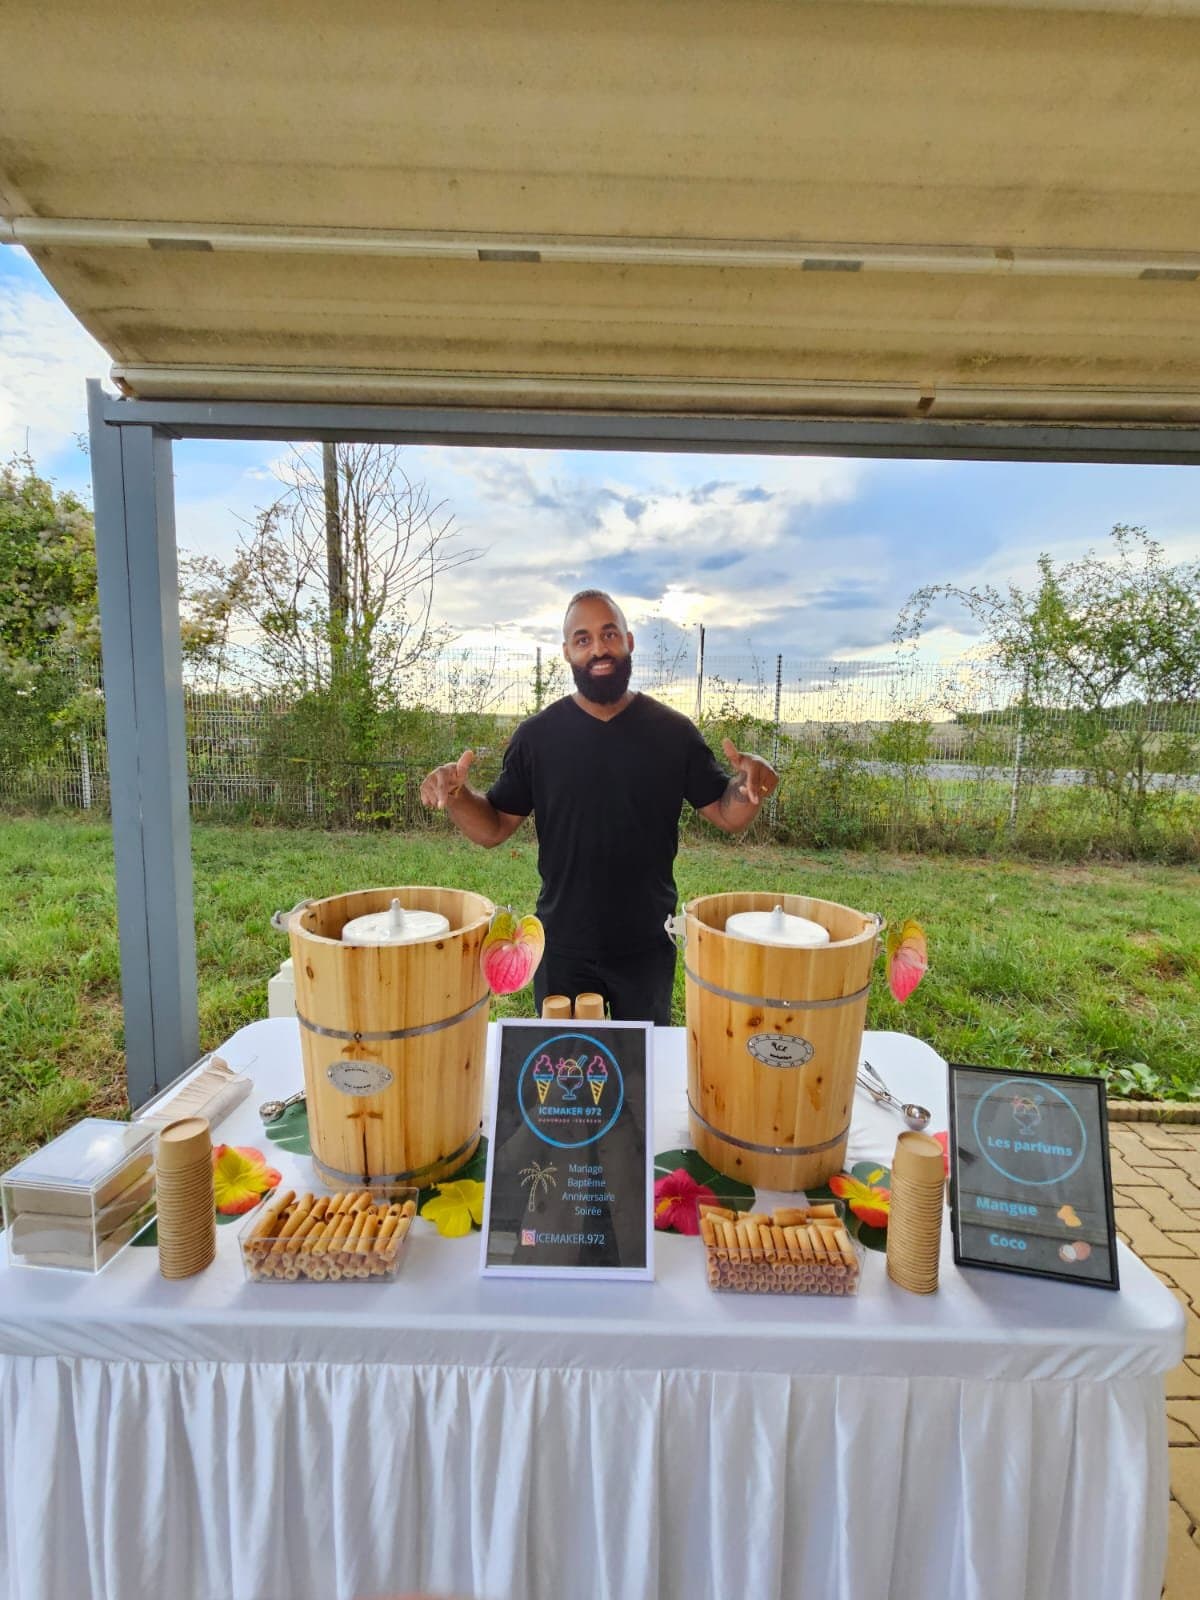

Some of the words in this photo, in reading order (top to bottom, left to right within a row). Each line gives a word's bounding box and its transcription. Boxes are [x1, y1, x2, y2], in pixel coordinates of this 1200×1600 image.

[988, 1136, 1010, 1149] Les
[1014, 1139, 1073, 1157] parfums
[568, 1164, 603, 1175] Mariage
[567, 1178, 606, 1188] Baptême
[562, 1192, 615, 1202] Anniversaire
[575, 1206, 602, 1216] Soirée
[976, 1197, 1038, 1217] Mangue
[989, 1233, 1027, 1250] Coco
